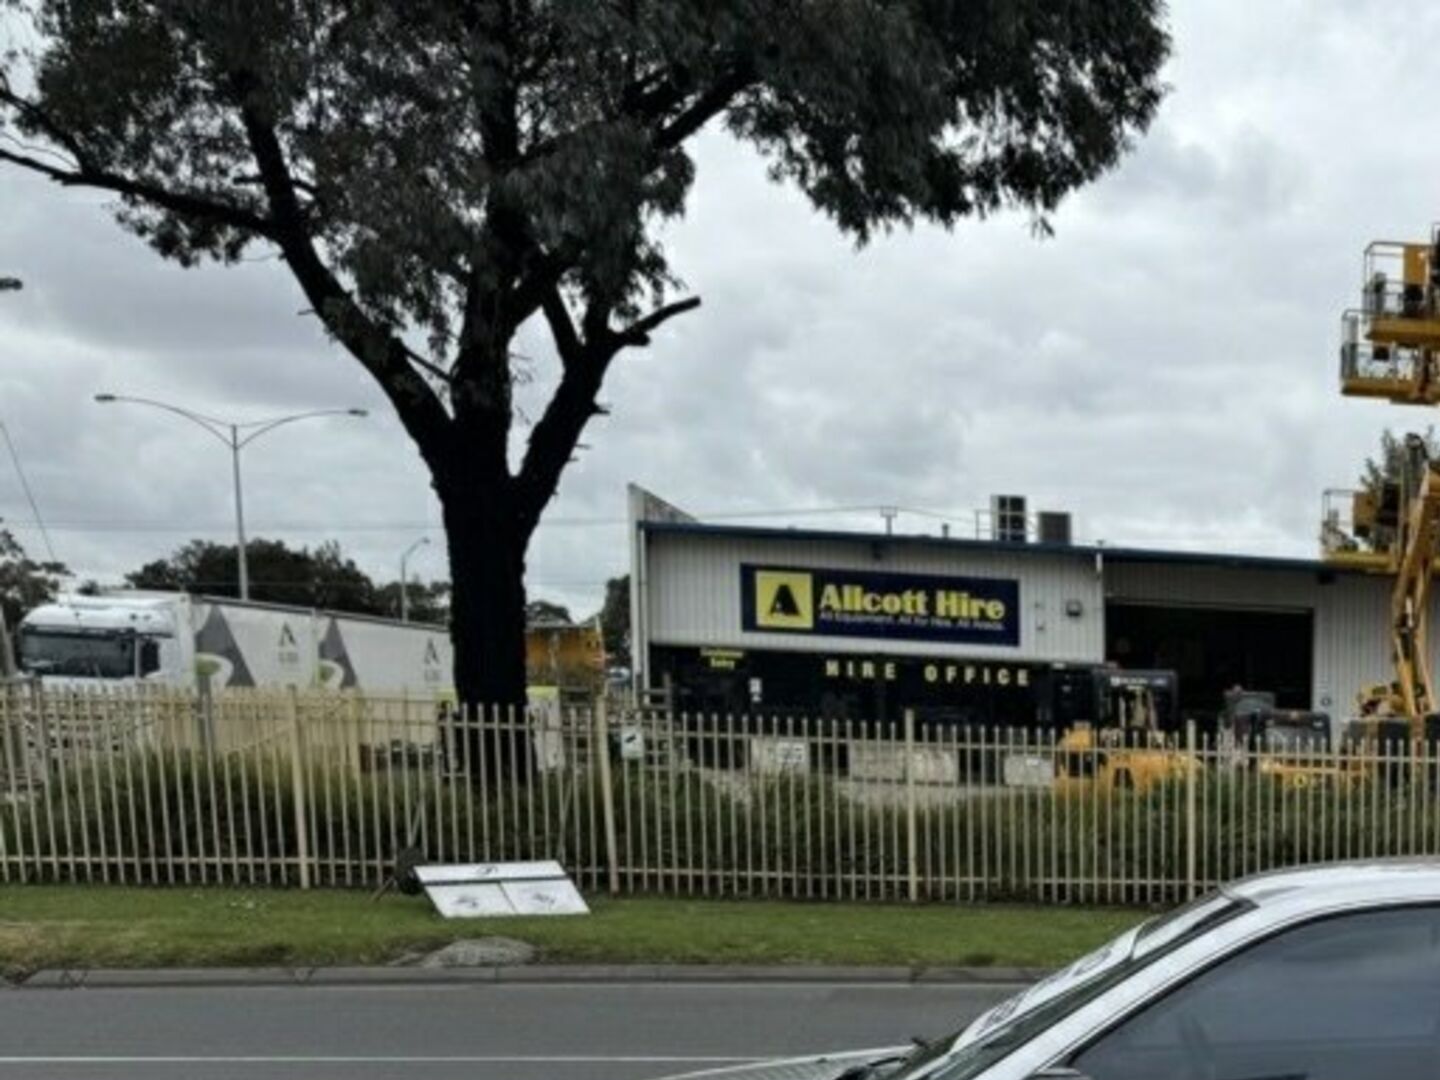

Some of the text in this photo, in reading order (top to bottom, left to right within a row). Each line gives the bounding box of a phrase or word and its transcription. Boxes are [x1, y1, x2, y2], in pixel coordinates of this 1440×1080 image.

[819, 584, 1006, 620] Allcott Hire
[826, 660, 1028, 687] HIRE OFFICE
